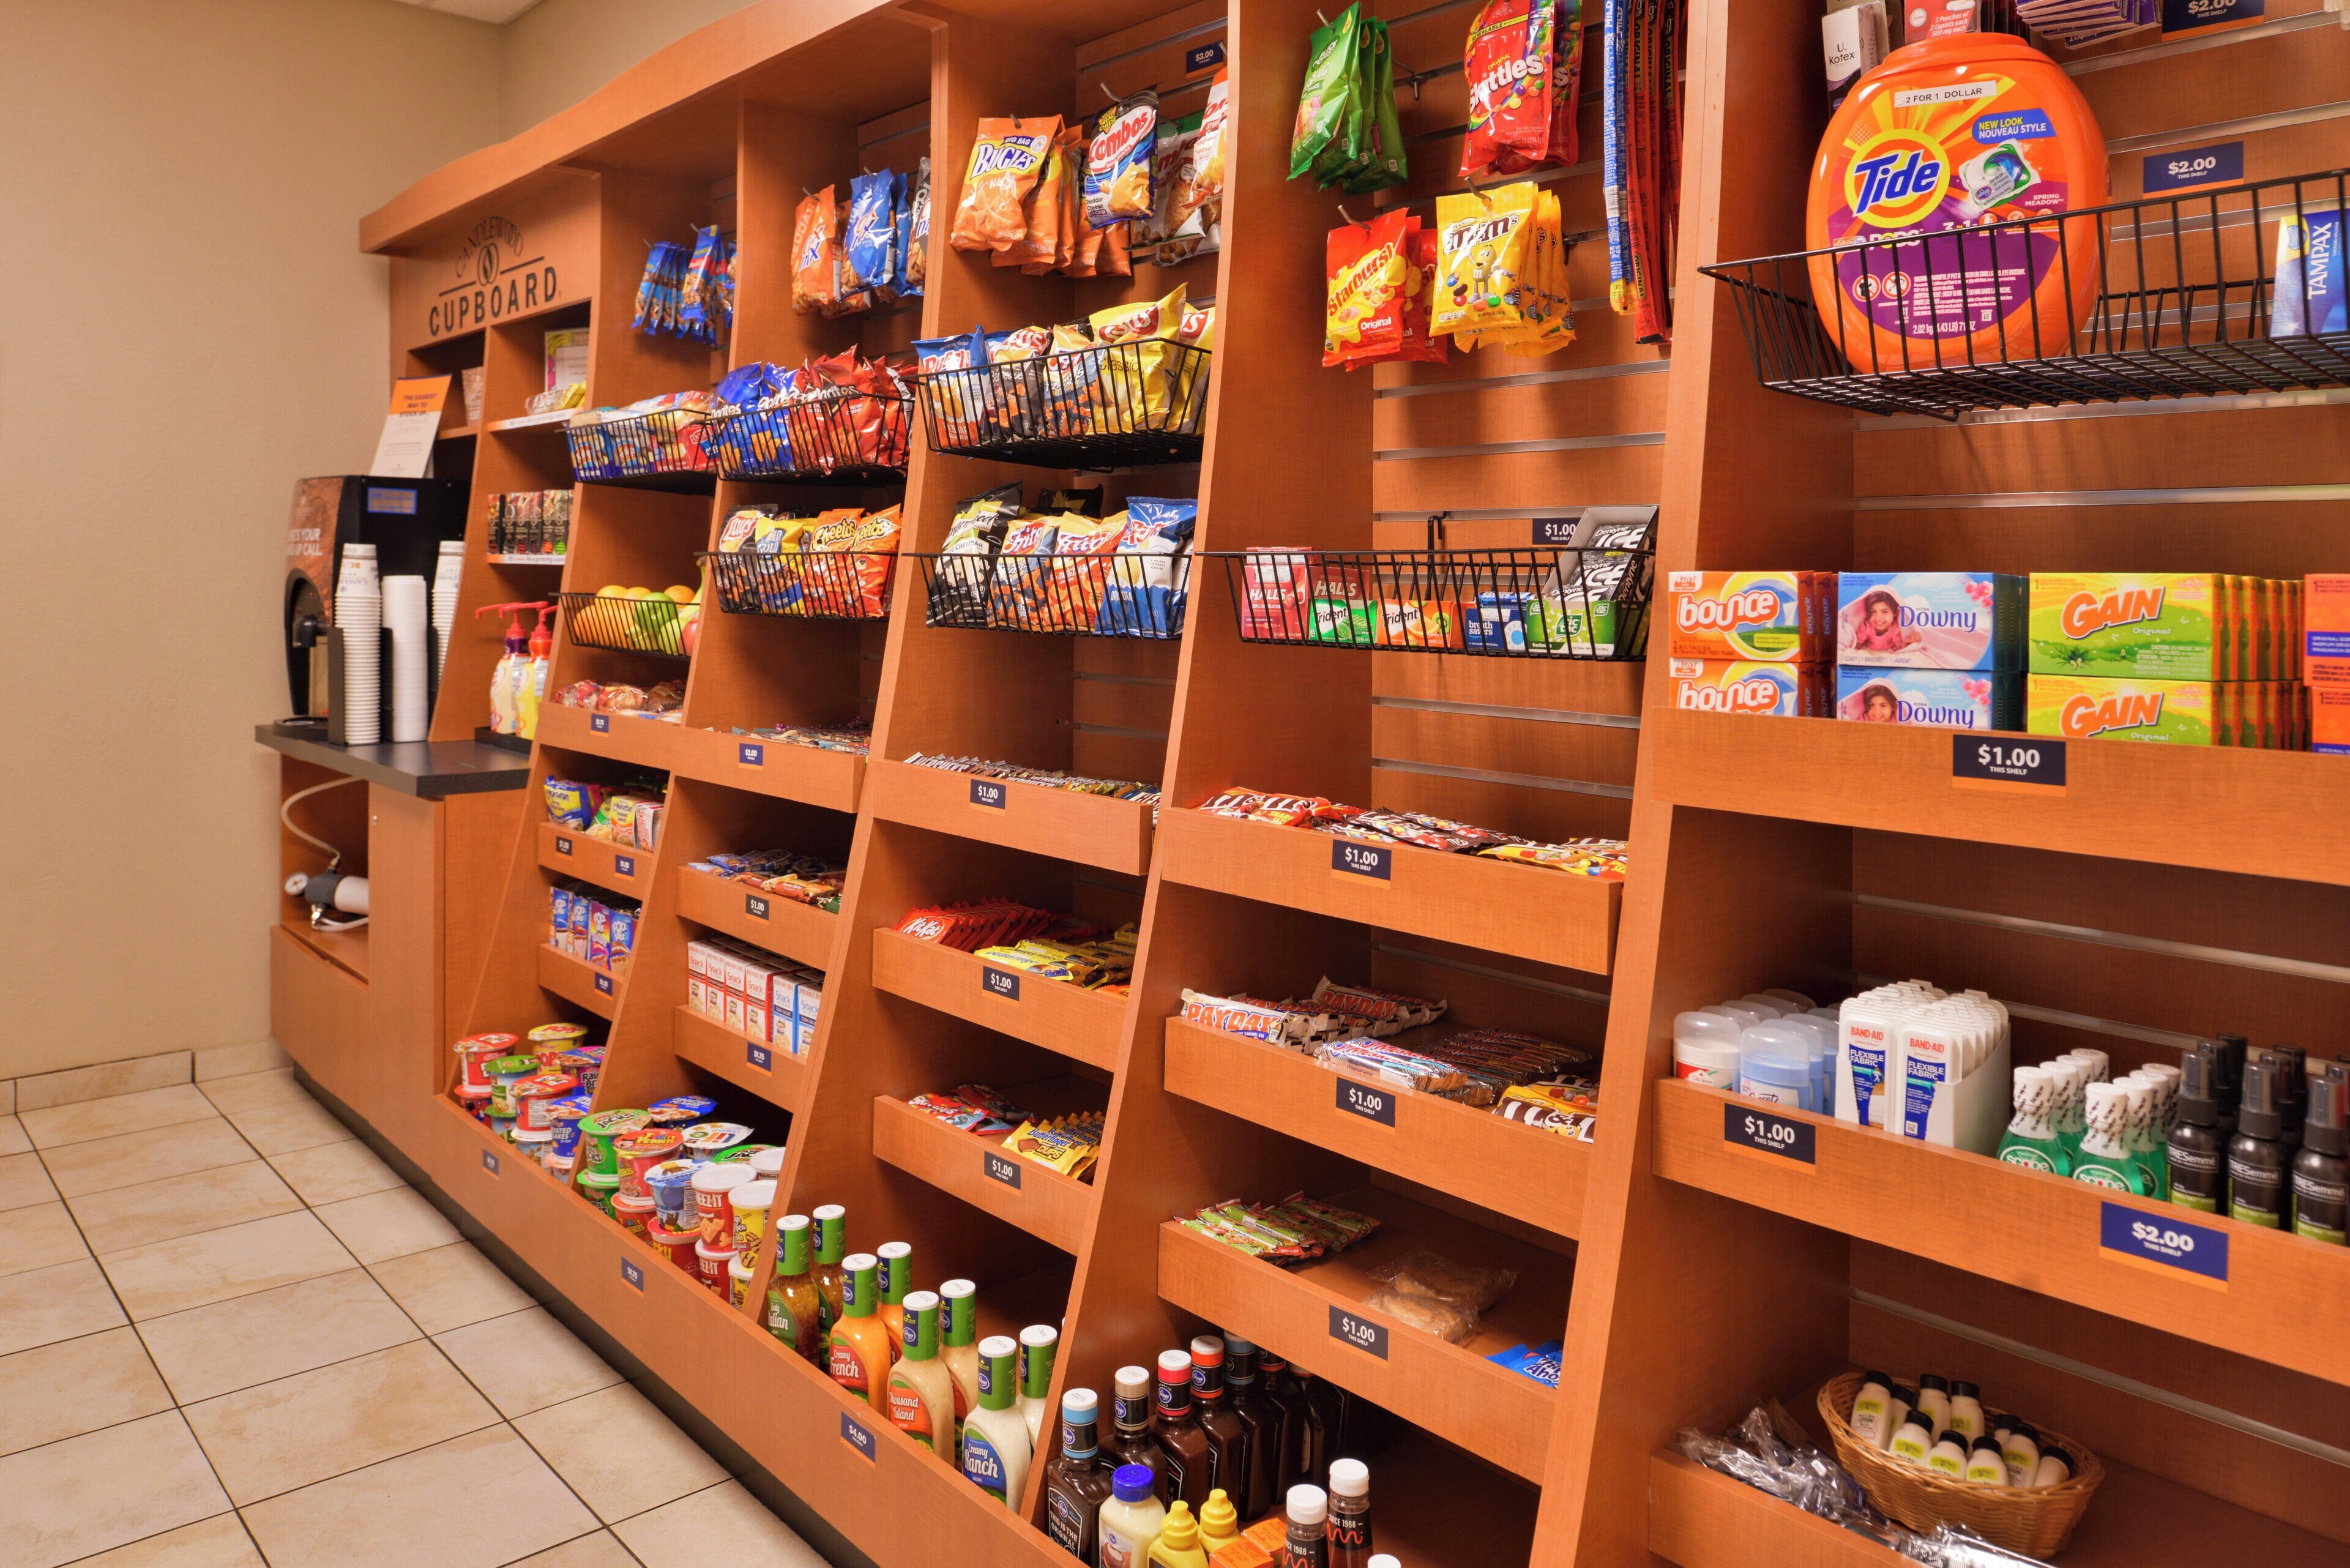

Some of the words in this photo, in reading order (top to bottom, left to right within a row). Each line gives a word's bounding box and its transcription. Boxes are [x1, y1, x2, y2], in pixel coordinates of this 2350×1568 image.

[1940, 13, 1960, 23] Pouches
[2210, 8, 2228, 17] SHELF
[1472, 23, 1504, 42] RESEALABLE
[1934, 20, 1954, 30] Caplets
[1195, 50, 1214, 62] $3.00
[1913, 93, 1932, 102] FOR
[1944, 88, 1982, 99] DOLLAR
[1099, 116, 1117, 132] CHEESE
[1101, 113, 1115, 125] REAL
[1979, 119, 1999, 130] NEW
[2000, 117, 2023, 127] LOOK
[1089, 111, 1149, 163] Combos
[1979, 125, 2020, 139] NOUVEAU
[2021, 123, 2046, 132] STYLE
[970, 143, 1037, 181] BUGLES
[2168, 157, 2217, 175] $2.00
[1853, 149, 1941, 217] Tide
[1085, 196, 1103, 205] Cheddar
[2307, 222, 2333, 300] TAMPAX
[429, 266, 557, 337] CUPBOARD
[1360, 316, 1392, 330] Original
[1913, 324, 1925, 334] 2.02
[1927, 324, 1933, 335] kg
[1949, 321, 1958, 332] LB)
[302, 528, 321, 541] YOUR
[811, 518, 856, 550] Cheetos
[1545, 523, 1576, 537] $1.00
[1594, 527, 1646, 548] ICE
[1595, 526, 1629, 537] Dentyne
[955, 540, 984, 550] CHEDDAR
[1250, 588, 1286, 601] HALLS
[1315, 580, 1357, 597] HALLS
[1679, 591, 1775, 627] bounce
[2062, 587, 2165, 639] GAIN
[1900, 606, 1977, 633] Downy
[2133, 627, 2172, 637] Original
[1679, 678, 1777, 713] bounce
[1898, 700, 1975, 730] Downy
[2061, 692, 2164, 737] GAIN
[2130, 732, 2170, 742] Original
[745, 748, 758, 758] $2.00
[1978, 744, 2040, 768] $1.00
[2007, 767, 2027, 775] SHELF
[978, 785, 999, 800] $1.00
[1269, 810, 1294, 822] SHARE
[1345, 848, 1378, 867] $1.00
[750, 898, 765, 912] $1.00
[690, 955, 704, 969] Snack
[708, 963, 723, 976] Snack
[727, 971, 742, 986] Snack
[990, 973, 1012, 990] $1.00
[748, 980, 764, 995] Snack
[775, 990, 791, 1005] Snack
[800, 1000, 819, 1014] Snack
[1186, 1002, 1283, 1033] PAYDAY
[1851, 1026, 1884, 1040] BAND-AID
[1910, 1038, 1944, 1053] BAND-AID
[753, 1050, 765, 1061] $1.75
[1850, 1049, 1884, 1062] FLEXIBLE
[1850, 1056, 1878, 1067] FABRIC
[1908, 1061, 1944, 1075] FLEXIBLE
[1908, 1067, 1939, 1080] FABRIC
[1349, 1087, 1382, 1111] $1.00
[1364, 1107, 1376, 1115] SHELF
[1027, 1127, 1071, 1148] Butterfinger
[1745, 1116, 1796, 1144] $1.00
[1754, 1136, 1766, 1145] THIS
[1767, 1138, 1785, 1149] SHELF
[1039, 1146, 1066, 1160] CUPS
[2168, 1146, 2217, 1167] TRESemmé
[992, 1159, 1013, 1178] $1.00
[2229, 1159, 2279, 1181] TRESemmé
[2293, 1174, 2345, 1197] TRESemmé
[2132, 1222, 2195, 1252] $2.00
[2143, 1241, 2159, 1252] THIS
[2160, 1246, 2183, 1257] SHELF
[1342, 1316, 1376, 1344] $1.00
[1348, 1334, 1359, 1342] THIS
[1359, 1337, 1369, 1347] SHELF
[834, 1347, 851, 1362] Creamy
[830, 1357, 860, 1379] French
[889, 1391, 919, 1409] Thousand
[893, 1407, 915, 1422] Island
[849, 1424, 867, 1445] $4.00
[968, 1443, 989, 1459] Creamy
[964, 1449, 999, 1479] Ranch
[1050, 1510, 1061, 1526] THIS
[1061, 1520, 1066, 1532] IS
[1066, 1525, 1079, 1542] THE
[1342, 1519, 1357, 1529] 1966
[1051, 1520, 1077, 1551] ORIGINAL
[1293, 1544, 1308, 1556] 1966
